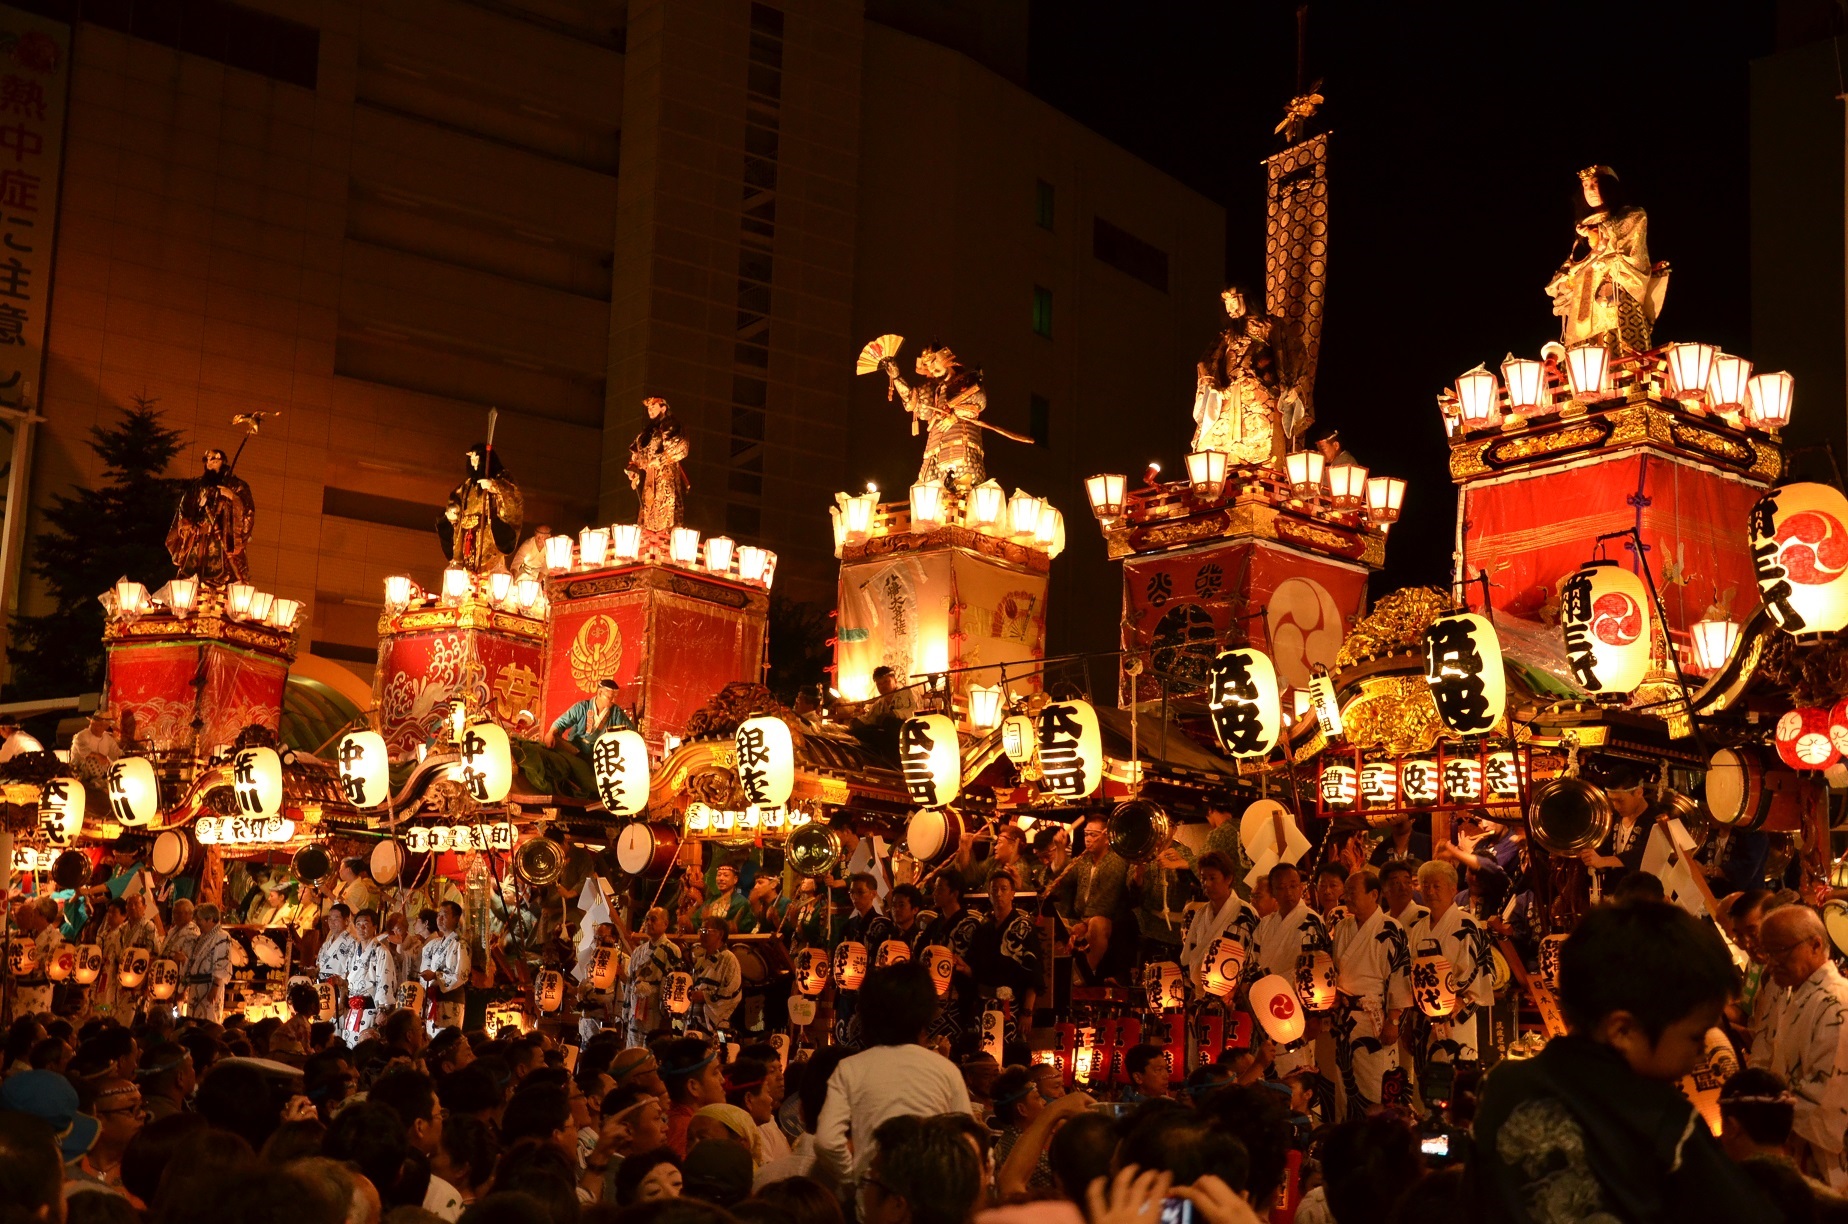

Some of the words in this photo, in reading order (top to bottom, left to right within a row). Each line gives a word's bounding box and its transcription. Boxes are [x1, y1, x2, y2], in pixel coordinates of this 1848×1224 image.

[593, 738, 629, 812] 銀座
[736, 726, 771, 805] 銀座
[1411, 962, 1442, 1012] 総代
